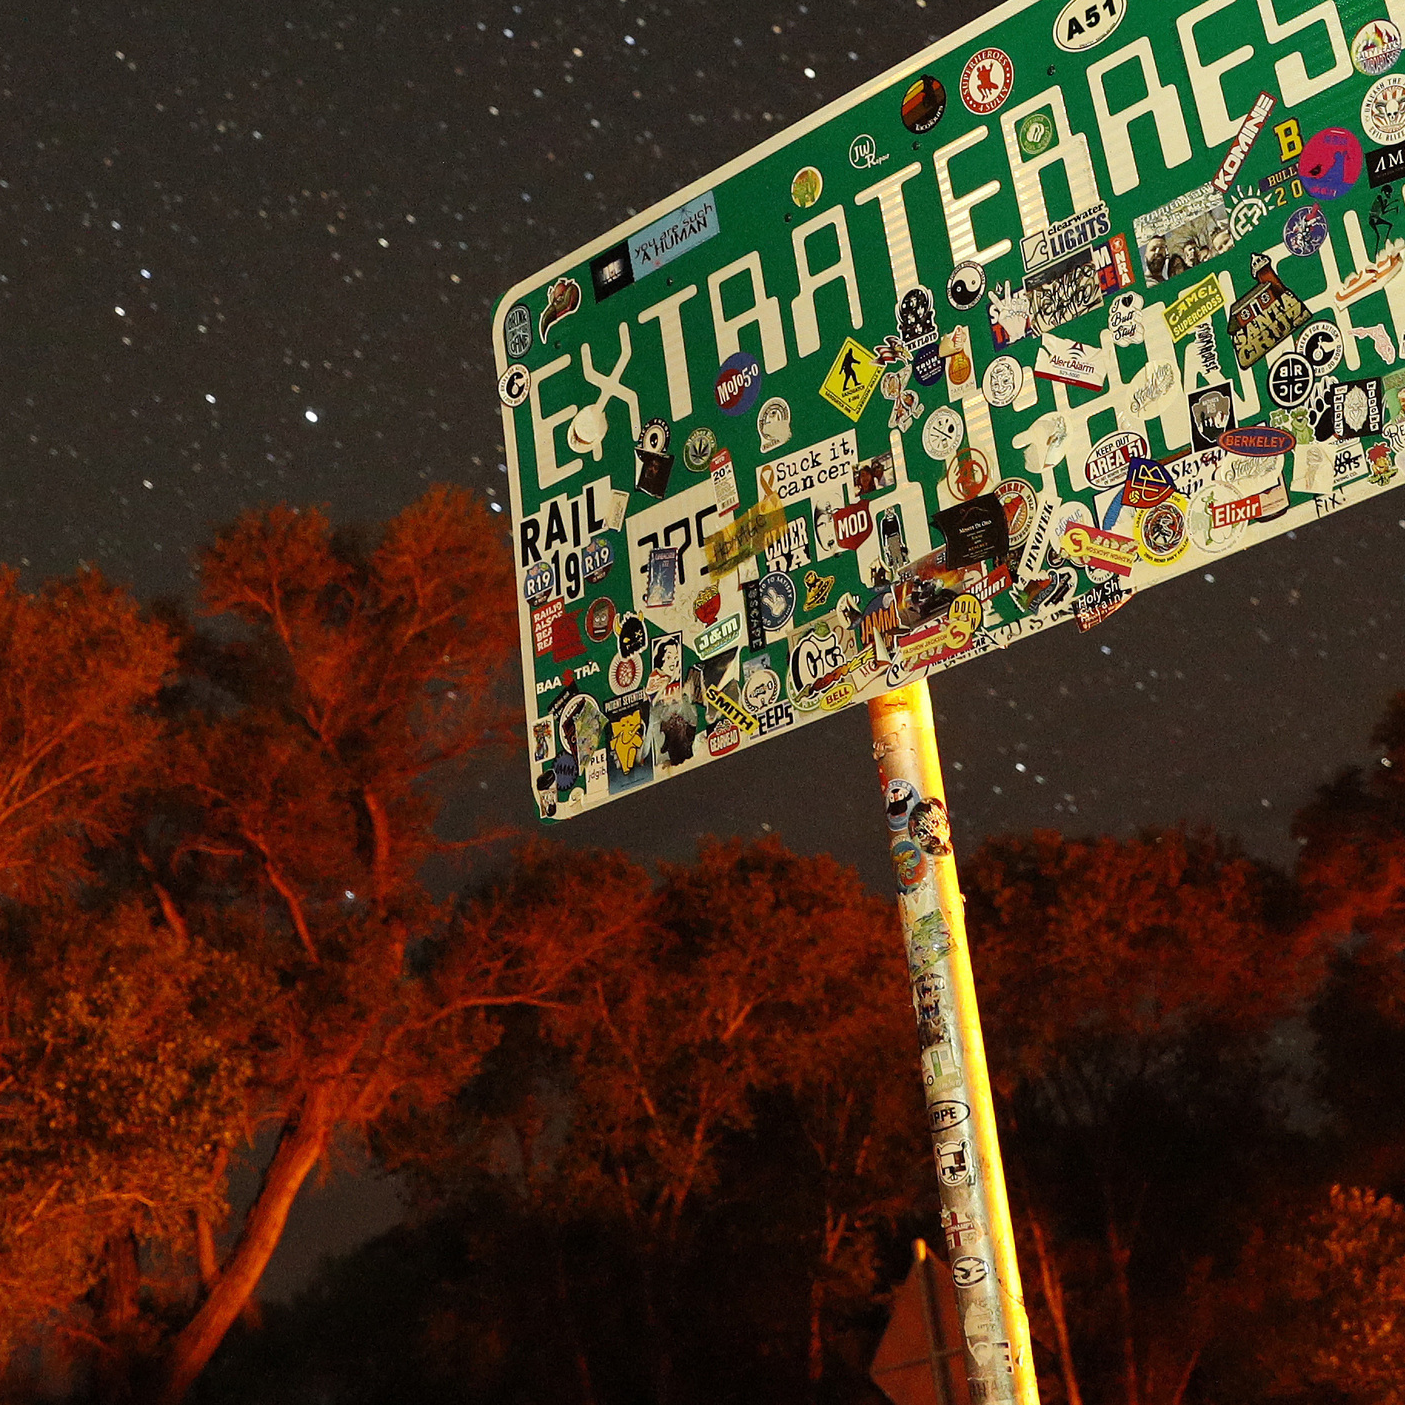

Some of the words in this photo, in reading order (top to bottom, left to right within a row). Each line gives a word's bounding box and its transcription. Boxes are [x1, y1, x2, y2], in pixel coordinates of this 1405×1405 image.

[962, 50, 1008, 96] SUPERHEROES
[1365, 80, 1388, 114] UNLEASH
[1387, 76, 1402, 86] THE
[1213, 92, 1275, 191] KOMINE
[1273, 117, 1303, 163] B
[1369, 125, 1384, 142] EVIL
[635, 238, 655, 259] you
[660, 223, 678, 241] are
[682, 202, 713, 227] such
[1047, 202, 1105, 237] clearwater
[1049, 213, 1110, 258] LIGHTS
[640, 249, 651, 265] A
[654, 217, 708, 257] HUMAN
[1116, 253, 1132, 287] NRA
[1167, 283, 1218, 324] CAMEL
[1172, 292, 1223, 337] SUPERCROSS
[1234, 291, 1303, 354] SANTA
[1237, 307, 1312, 366] CRUZ
[1088, 454, 1125, 481] AREA
[1128, 440, 1145, 463] 51
[1096, 441, 1113, 457] KEEP
[1115, 434, 1130, 449] OUT
[1225, 434, 1286, 449] BERKELEY
[776, 449, 822, 482] Suck
[777, 460, 850, 499] cancer
[520, 485, 606, 568] RAIL
[837, 509, 868, 541] MOD
[1214, 500, 1259, 526] Elixir
[1025, 499, 1056, 572] PINOTEK
[551, 549, 582, 600] 19
[583, 546, 611, 574] R19
[525, 570, 552, 595] R19
[1077, 591, 1101, 611] Holy
[706, 687, 760, 737] SMITH
[825, 686, 851, 705] BELL
[753, 702, 795, 738] EEPS
